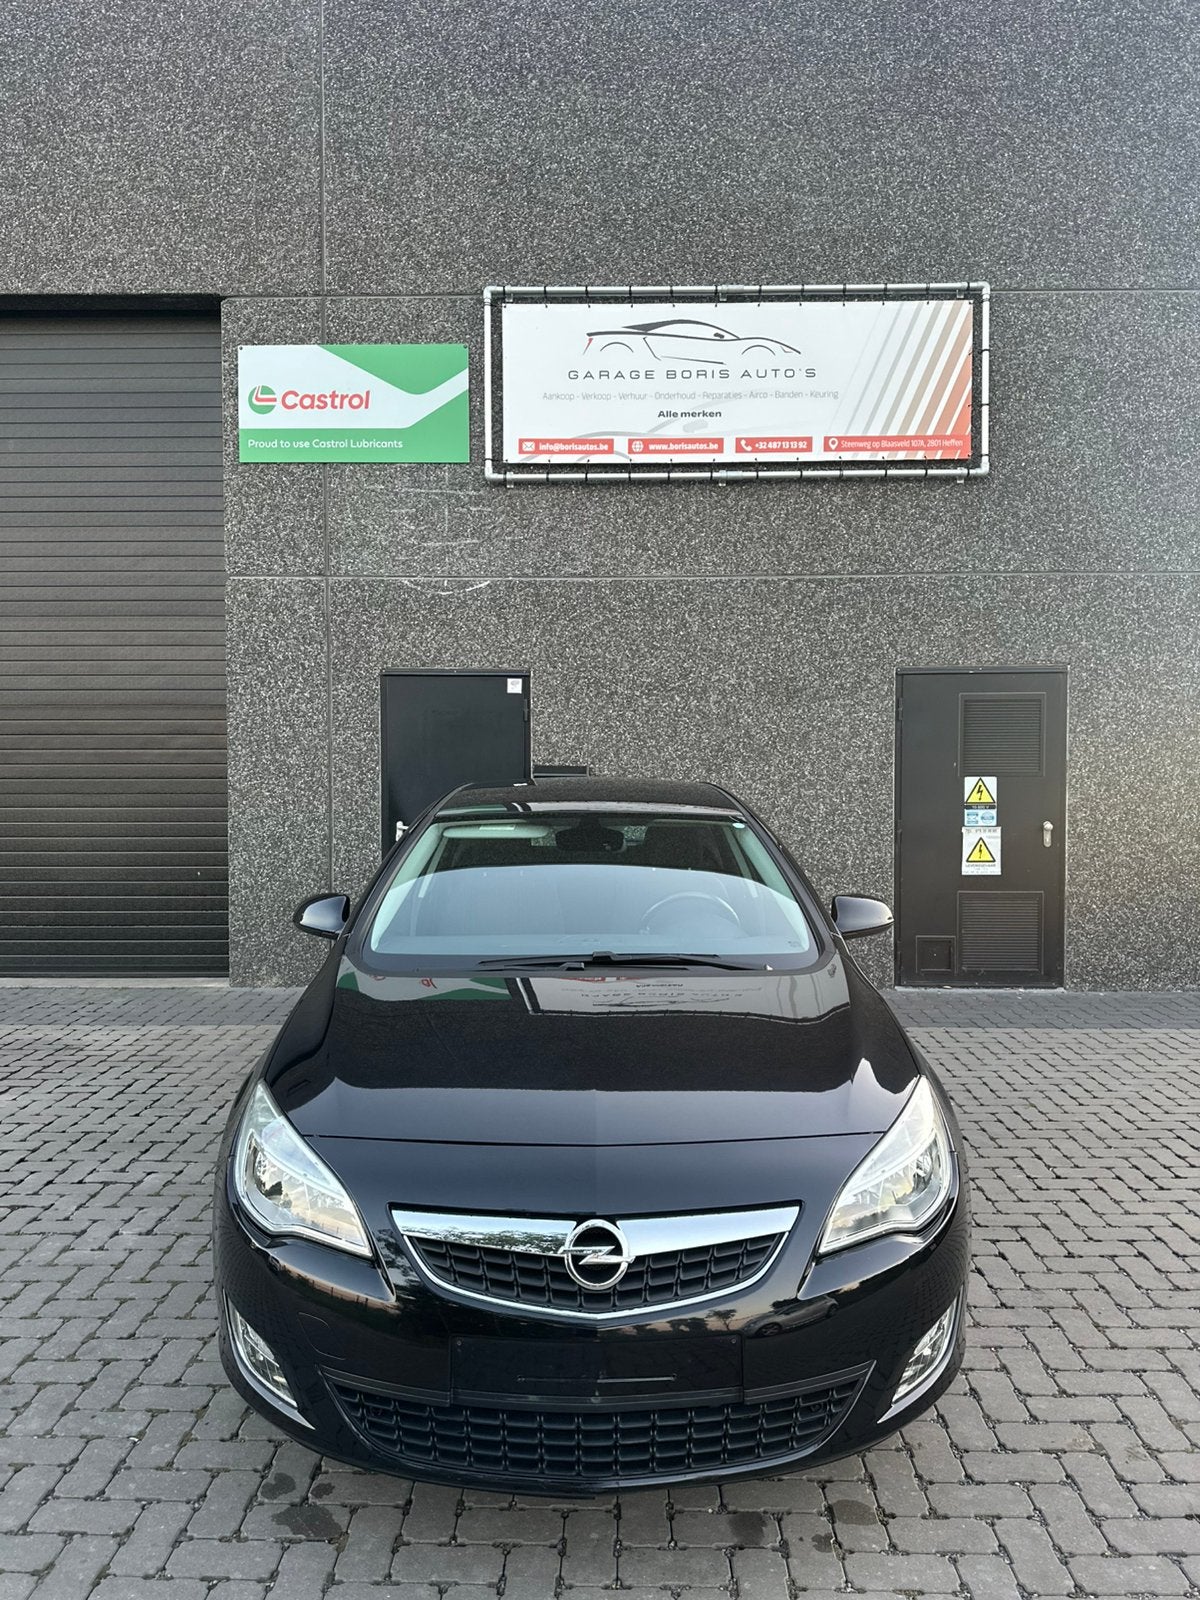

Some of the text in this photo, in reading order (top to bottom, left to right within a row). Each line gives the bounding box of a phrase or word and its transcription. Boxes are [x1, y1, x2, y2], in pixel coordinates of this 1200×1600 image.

[568, 370, 656, 380] GARAGE
[666, 369, 730, 379] BORIS
[281, 390, 371, 410] Castrol
[542, 392, 575, 401] Aankoop
[581, 392, 612, 401] Verkoop
[654, 391, 696, 400] Onderhoud
[702, 391, 743, 400] Reparaties
[749, 390, 768, 399] Airco
[774, 390, 803, 399] Banden
[809, 390, 839, 399] Keuring
[657, 410, 722, 418] Alle merken
[247, 439, 278, 449] Proud
[279, 439, 291, 448] to
[312, 439, 349, 448] Castrol
[350, 439, 403, 449] Lubricants
[539, 442, 609, 451] info@borisautos.be
[648, 441, 719, 450] www.borisautos.be
[755, 441, 767, 449] +32
[841, 440, 872, 449] Steenweg
[872, 441, 880, 449] op
[881, 439, 911, 448] Blaasveld
[942, 438, 963, 447] Heffen
